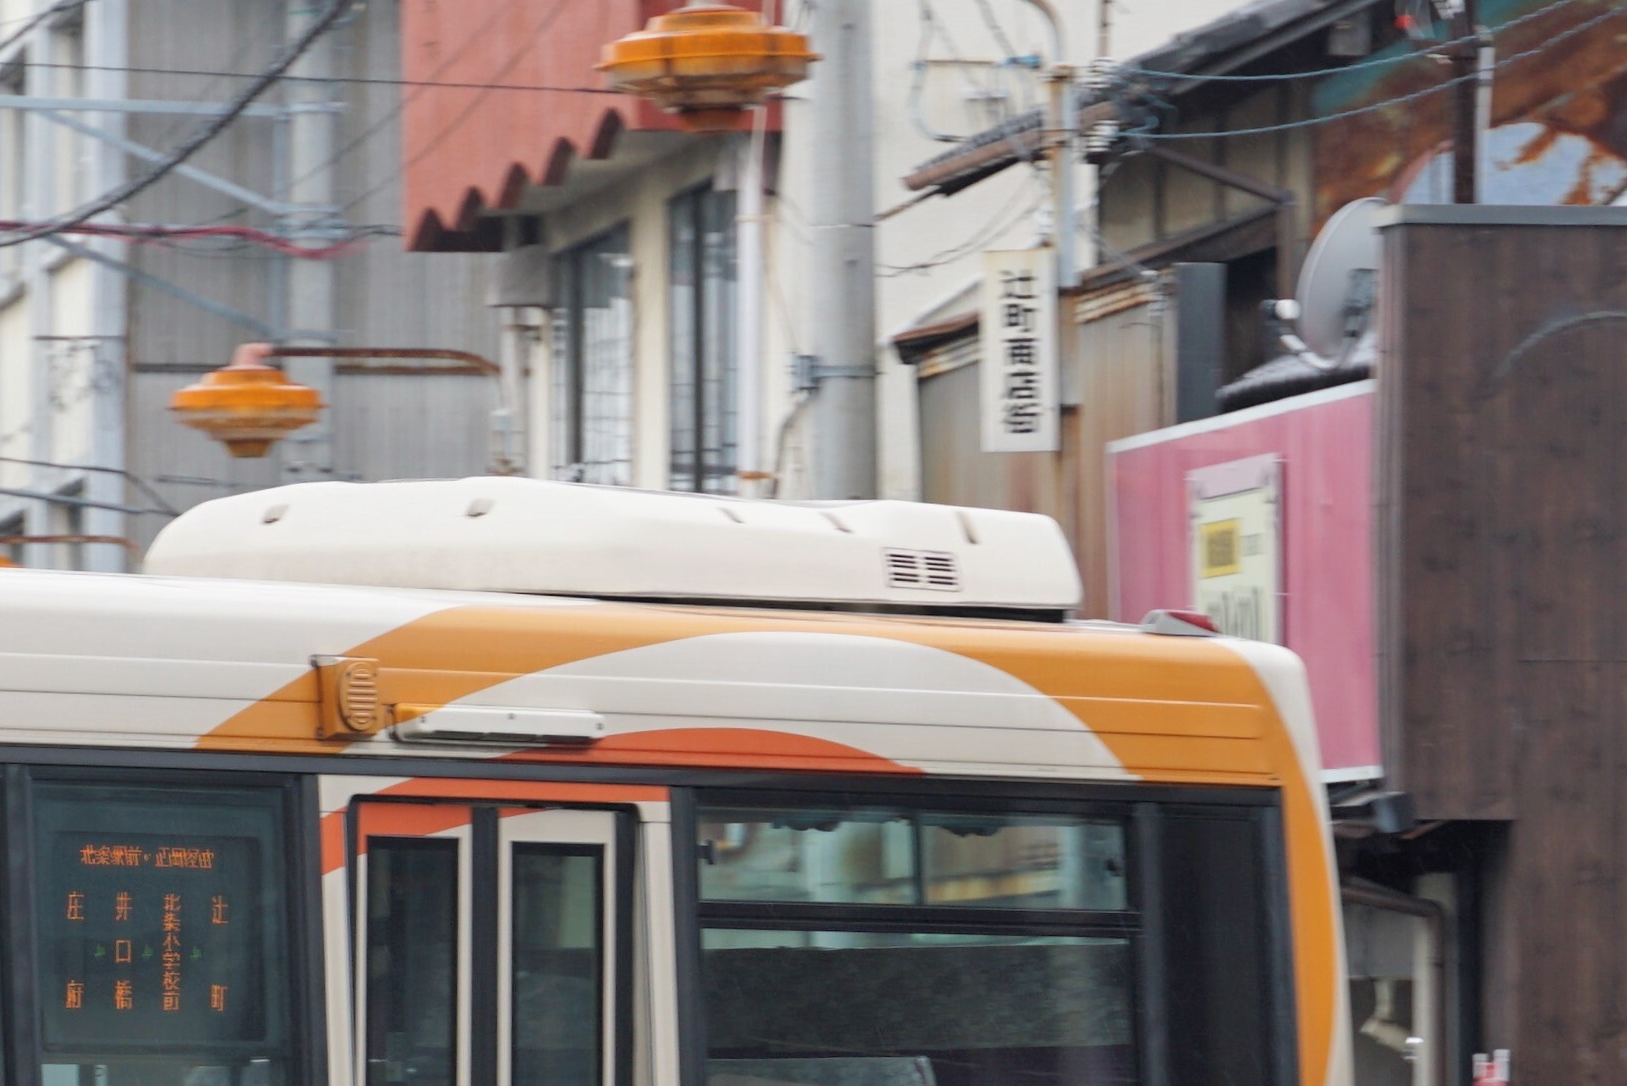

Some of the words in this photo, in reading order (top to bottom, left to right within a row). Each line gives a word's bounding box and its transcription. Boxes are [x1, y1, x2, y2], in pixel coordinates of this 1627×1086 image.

[1000, 270, 1042, 434] 辻町商店街
